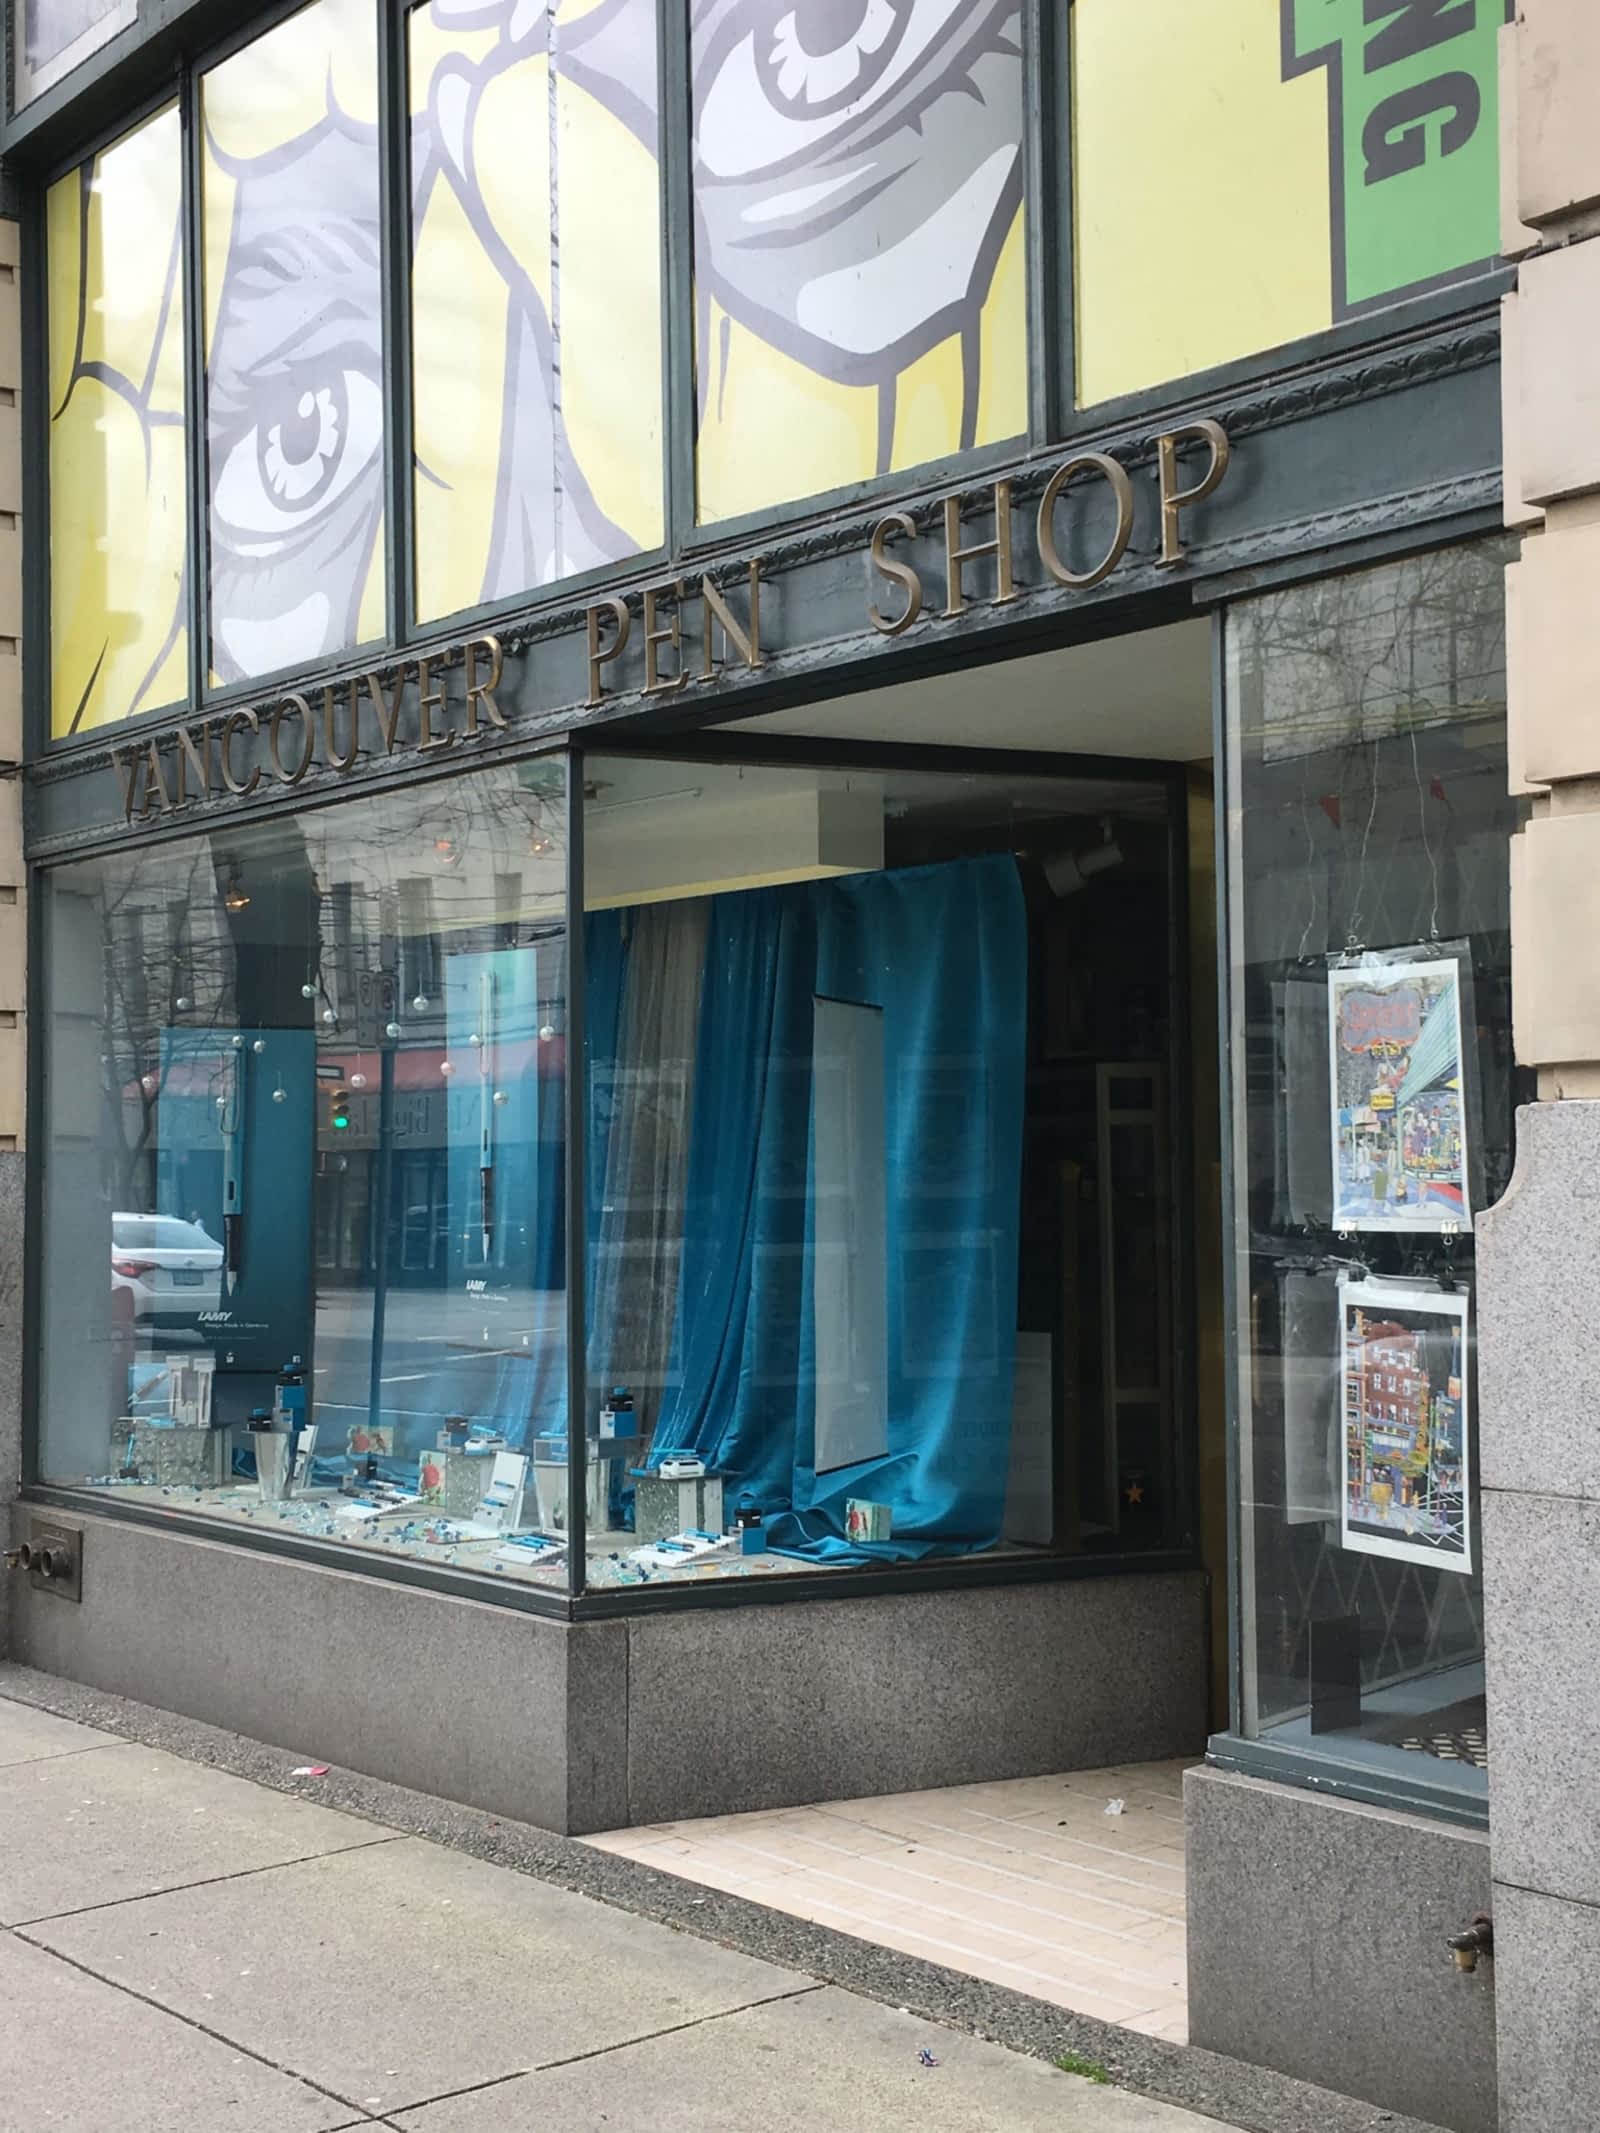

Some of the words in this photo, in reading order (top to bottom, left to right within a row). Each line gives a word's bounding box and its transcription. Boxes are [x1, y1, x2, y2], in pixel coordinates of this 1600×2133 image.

[111, 636, 509, 824] VANCOUVER
[585, 556, 764, 709] PEN
[869, 419, 1230, 637] SHOP
[197, 1311, 233, 1322] LAMY
